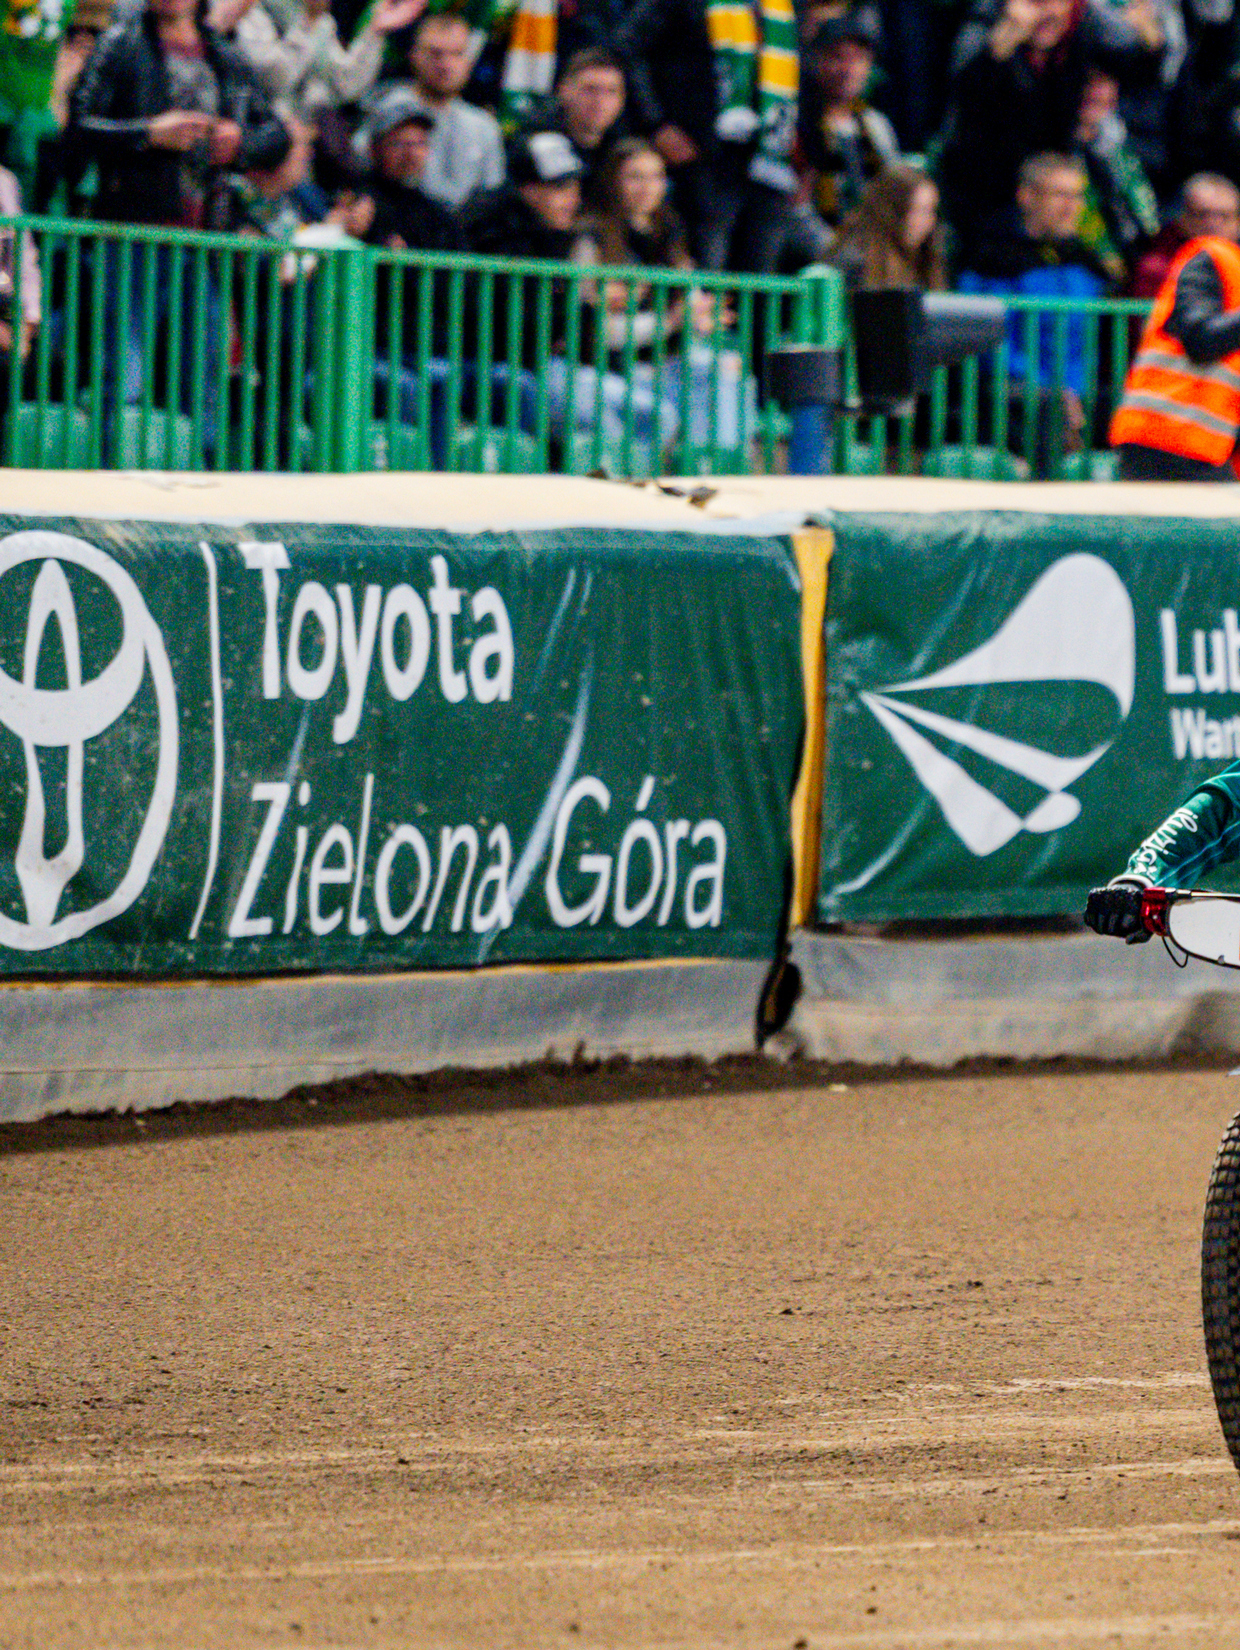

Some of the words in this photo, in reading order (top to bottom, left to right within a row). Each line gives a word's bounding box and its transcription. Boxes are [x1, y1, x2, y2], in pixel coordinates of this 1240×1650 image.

[239, 541, 514, 745] Toyota
[228, 773, 514, 938] Zielona
[546, 774, 727, 930] Góra
